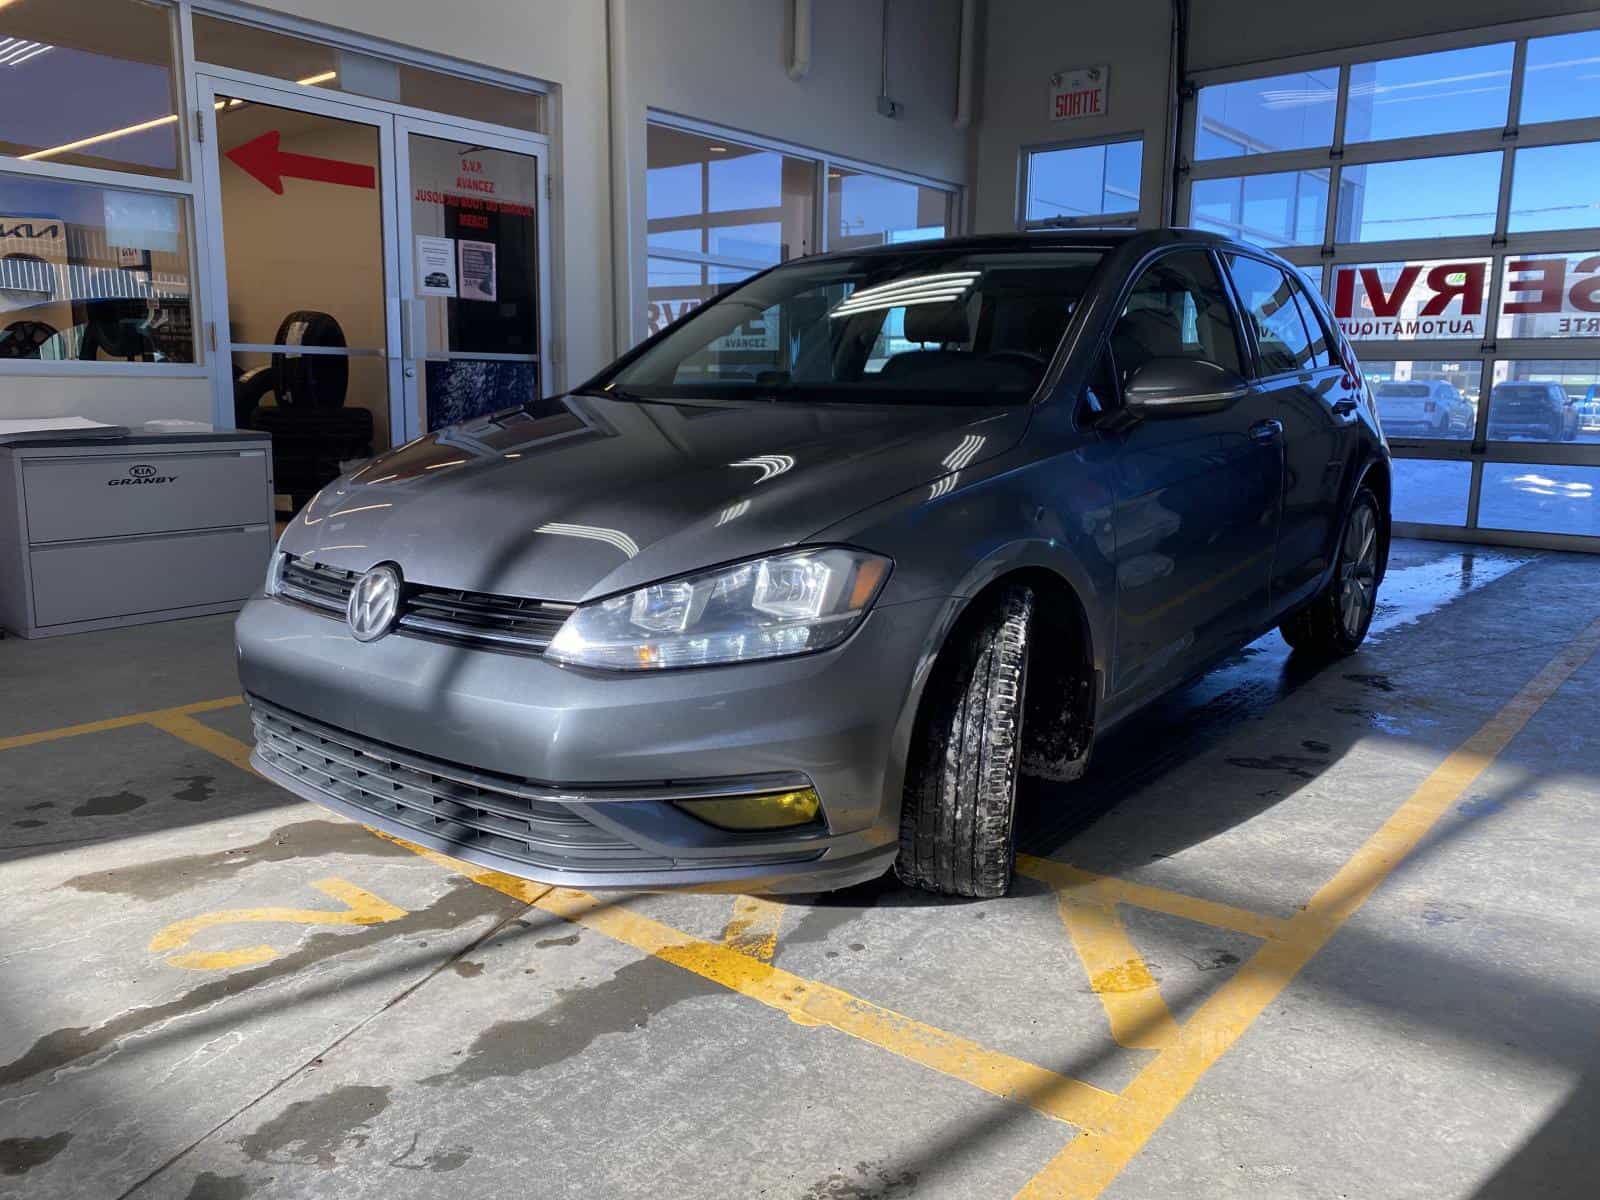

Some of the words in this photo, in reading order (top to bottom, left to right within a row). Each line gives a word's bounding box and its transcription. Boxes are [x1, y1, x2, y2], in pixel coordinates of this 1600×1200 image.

[1056, 89, 1101, 117] SORTIE
[456, 177, 495, 193] AVANCEZ
[108, 476, 177, 486] GRANBY
